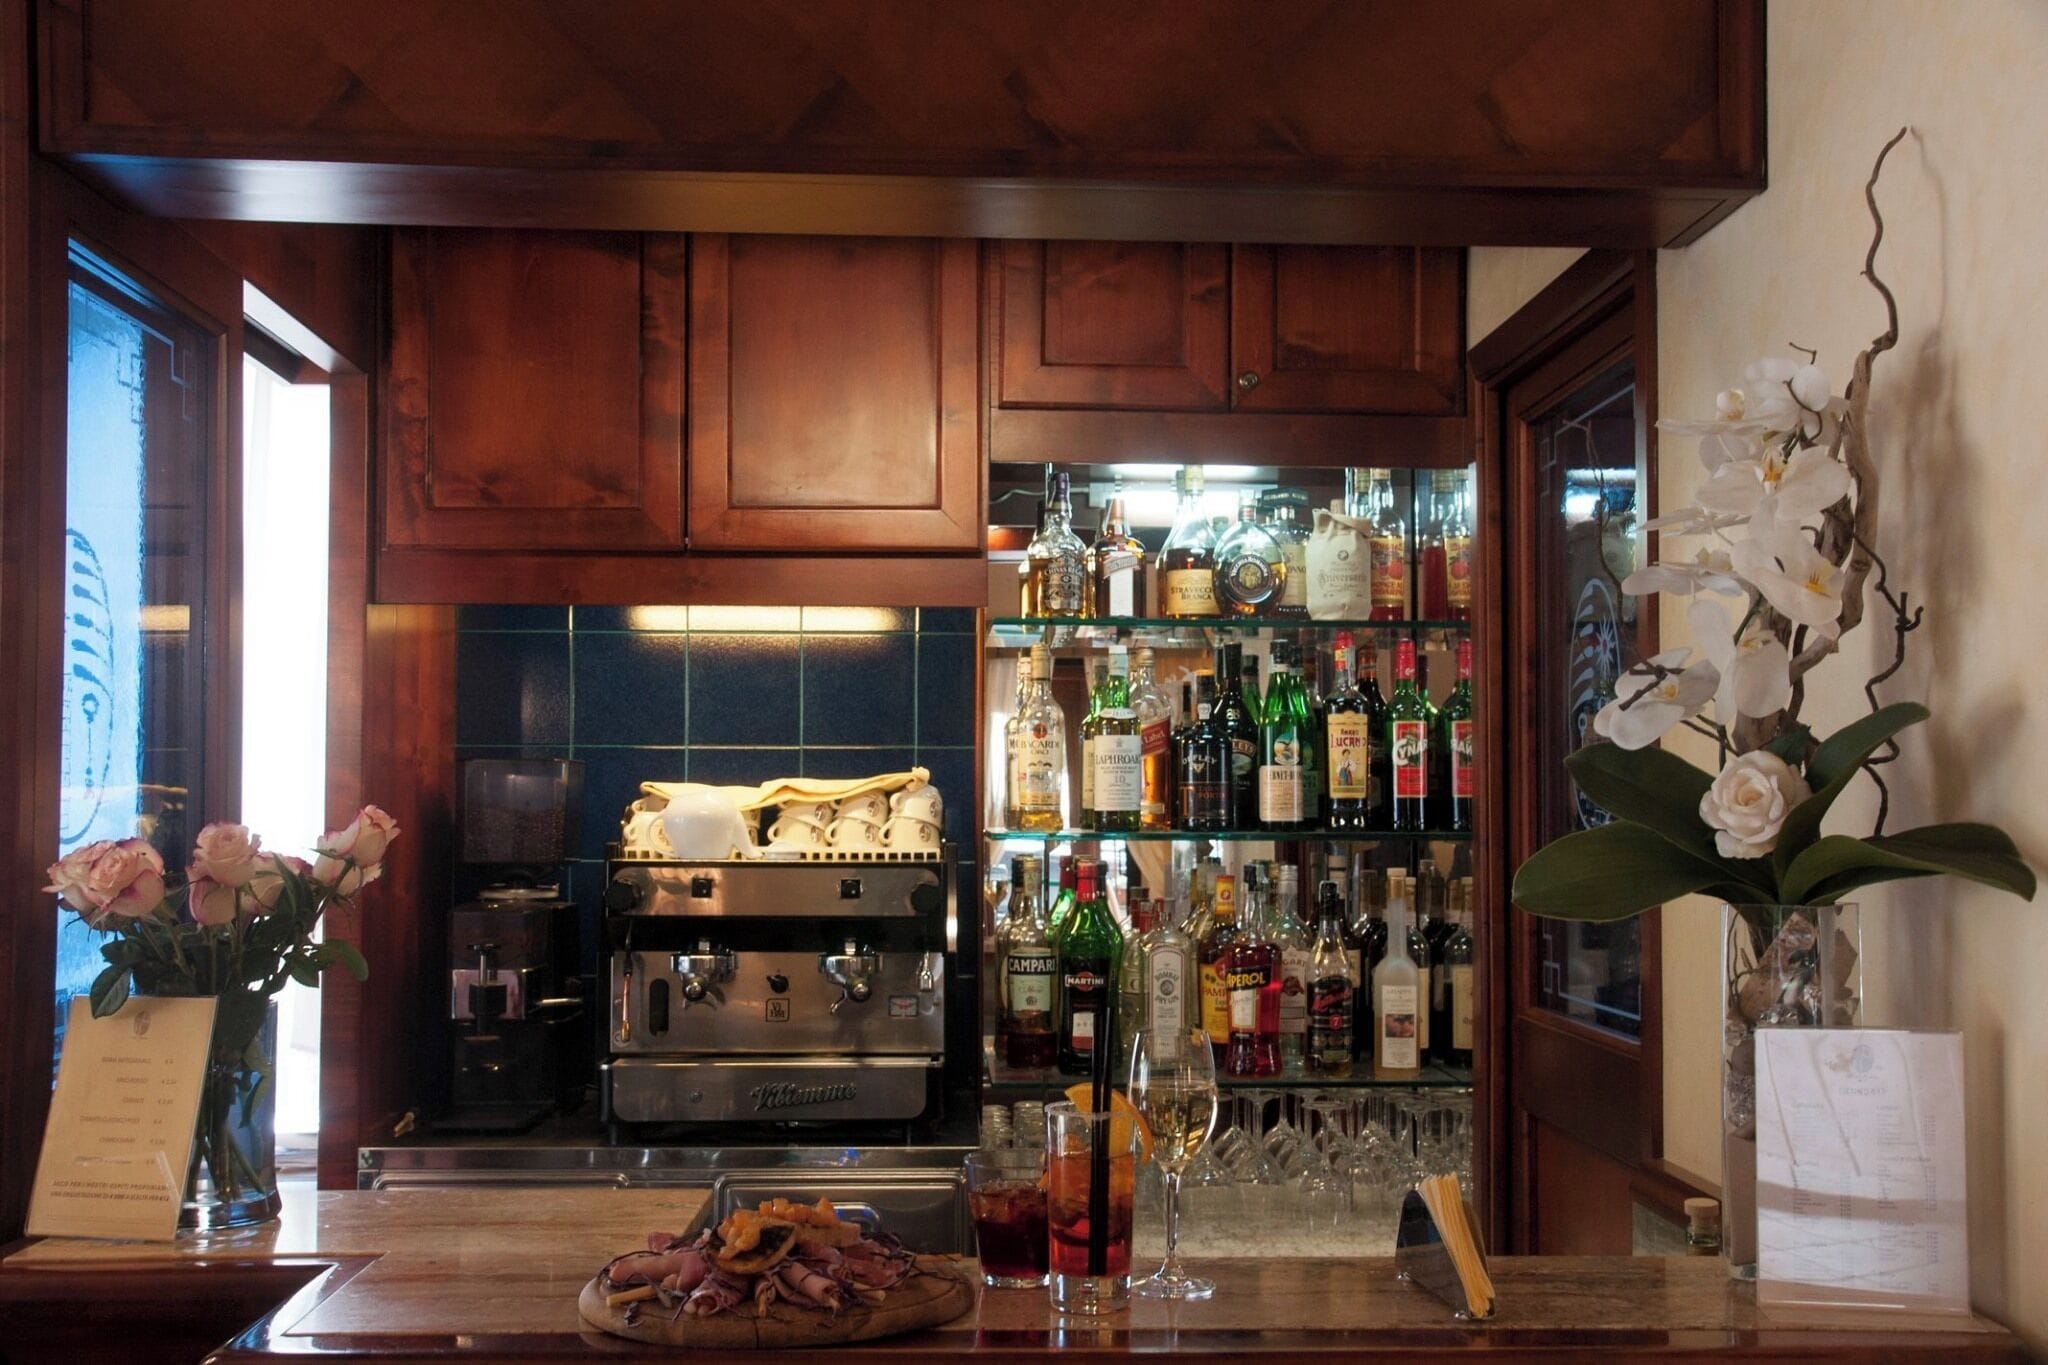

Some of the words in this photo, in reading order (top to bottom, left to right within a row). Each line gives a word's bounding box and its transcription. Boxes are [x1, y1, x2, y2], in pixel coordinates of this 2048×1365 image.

[1143, 731, 1166, 744] Label
[1331, 734, 1366, 748] LUCANO
[1232, 741, 1256, 754] LEYS
[1009, 958, 1055, 972] CAMPARI
[1227, 972, 1266, 987] APEROL
